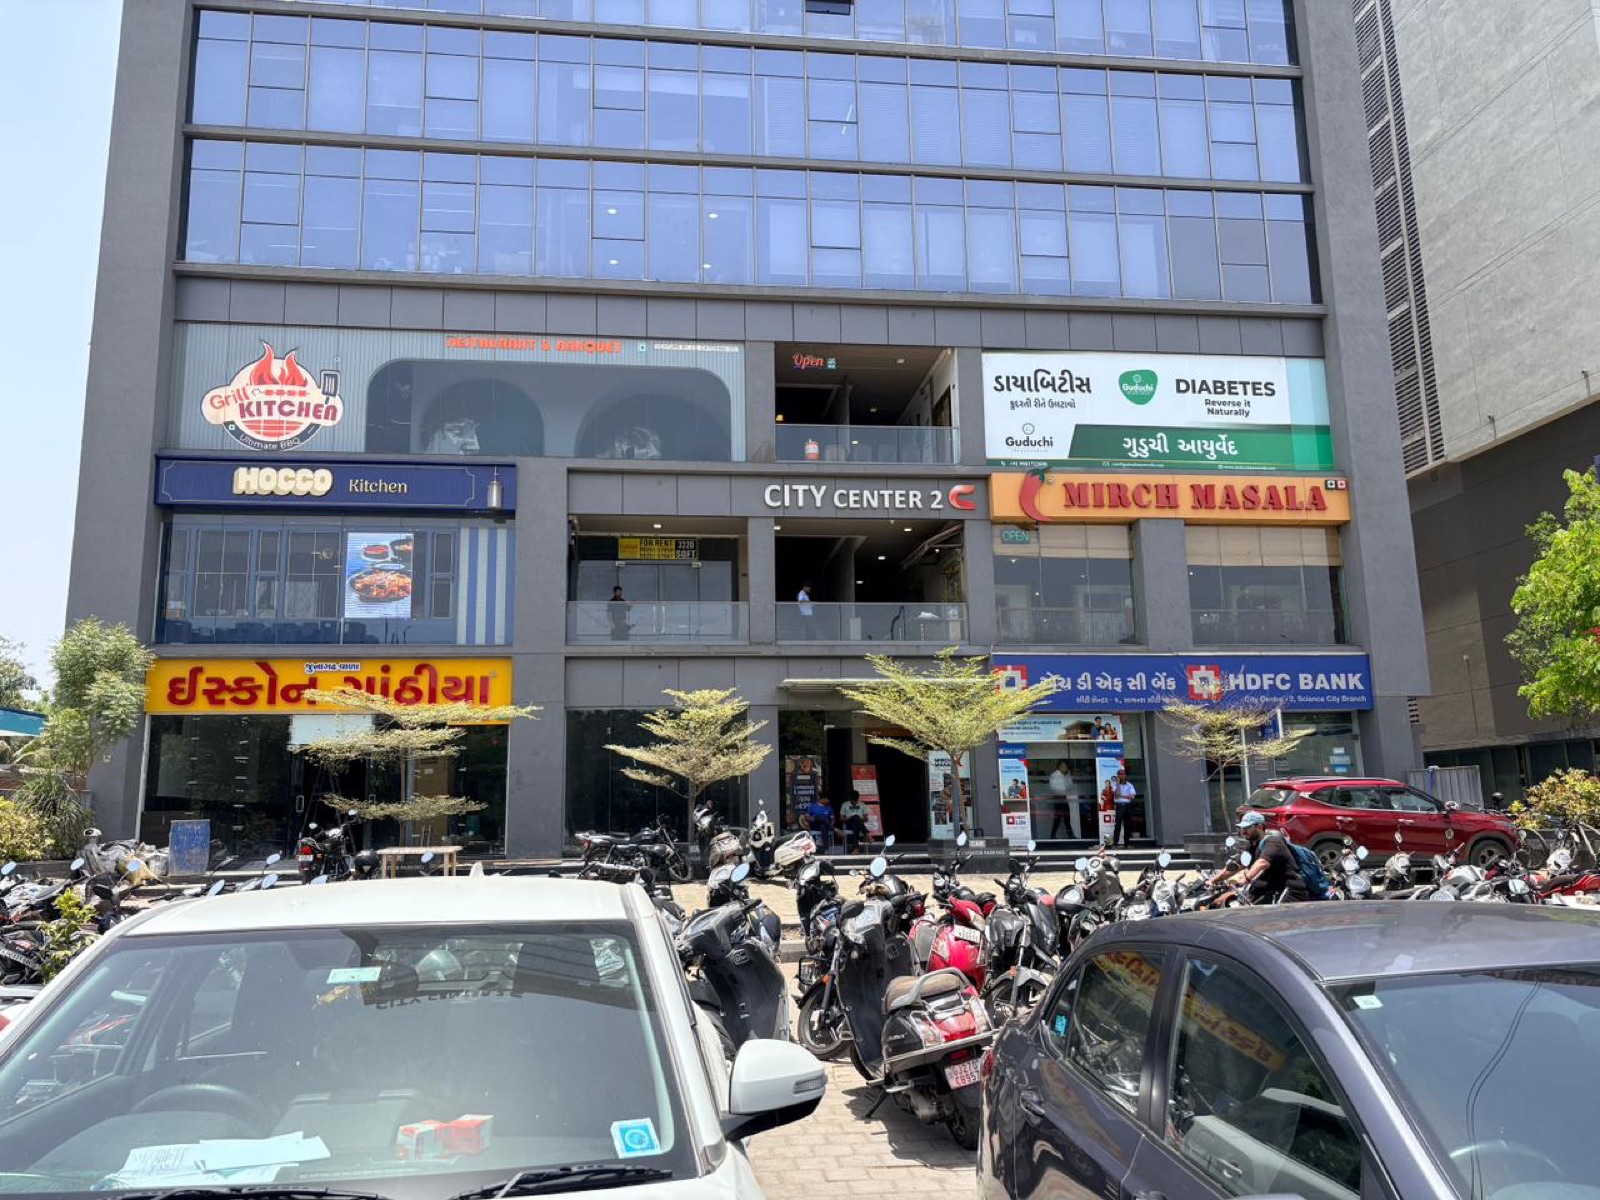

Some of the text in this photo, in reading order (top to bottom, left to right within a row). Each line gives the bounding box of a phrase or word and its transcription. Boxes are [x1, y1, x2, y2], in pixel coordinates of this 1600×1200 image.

[541, 339, 551, 351] &
[792, 353, 825, 369] Open
[993, 368, 1092, 394] ડાયાબિટીસ
[1122, 383, 1154, 391] Guduchi
[1175, 378, 1276, 397] DIABETES
[210, 386, 250, 410] Grill
[1204, 398, 1251, 408] Reverse it
[1207, 407, 1251, 418] Naturally
[280, 437, 301, 450] BBQ
[1005, 435, 1053, 447] Guduchi
[1122, 432, 1239, 460] ગુડુચી આયુર્વેદ
[233, 467, 408, 497] HOCCO Kitchen
[764, 484, 944, 509] CITY CENTER 2
[1062, 482, 1329, 512] MIRCH MASALA
[1002, 530, 1030, 541] OPEN
[1076, 672, 1092, 690] ડી
[1126, 672, 1147, 690] સી
[1228, 673, 1365, 691] HDFC BANK
